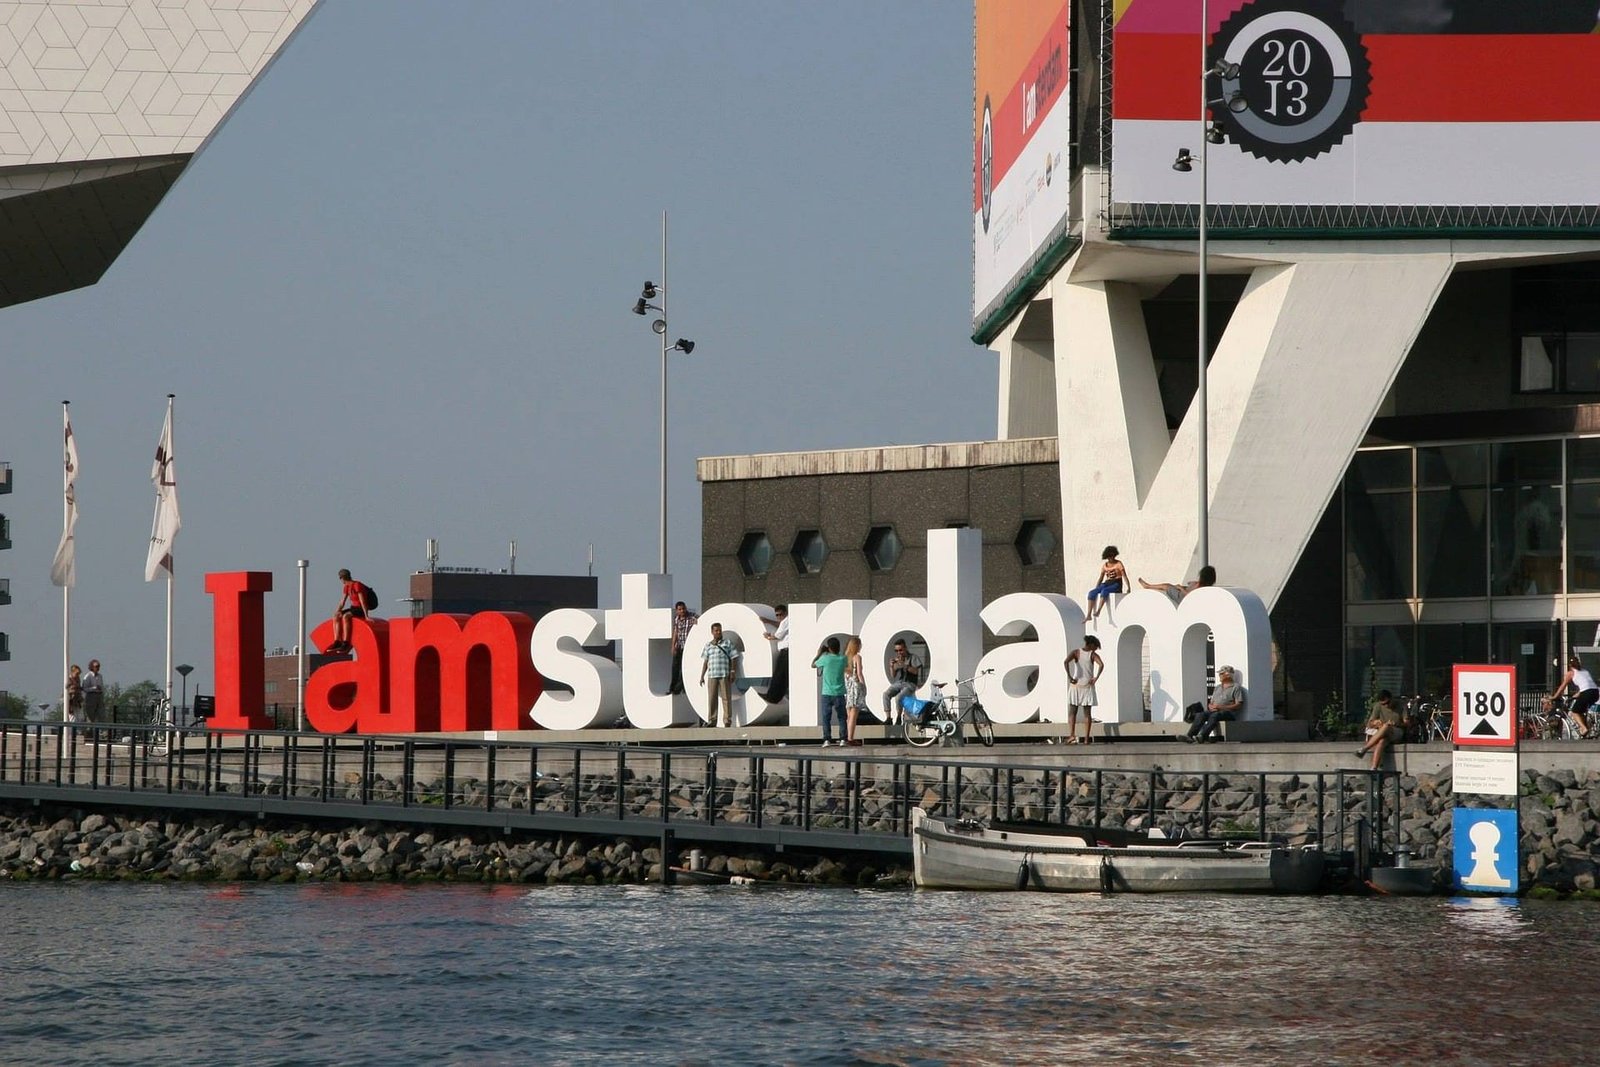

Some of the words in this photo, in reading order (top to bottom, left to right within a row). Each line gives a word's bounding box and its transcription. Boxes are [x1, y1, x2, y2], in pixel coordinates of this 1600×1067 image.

[1262, 39, 1311, 76] 20
[1264, 79, 1308, 116] 13
[204, 571, 273, 733] I
[305, 527, 1274, 733] amsterdam
[1463, 691, 1506, 717] 180
